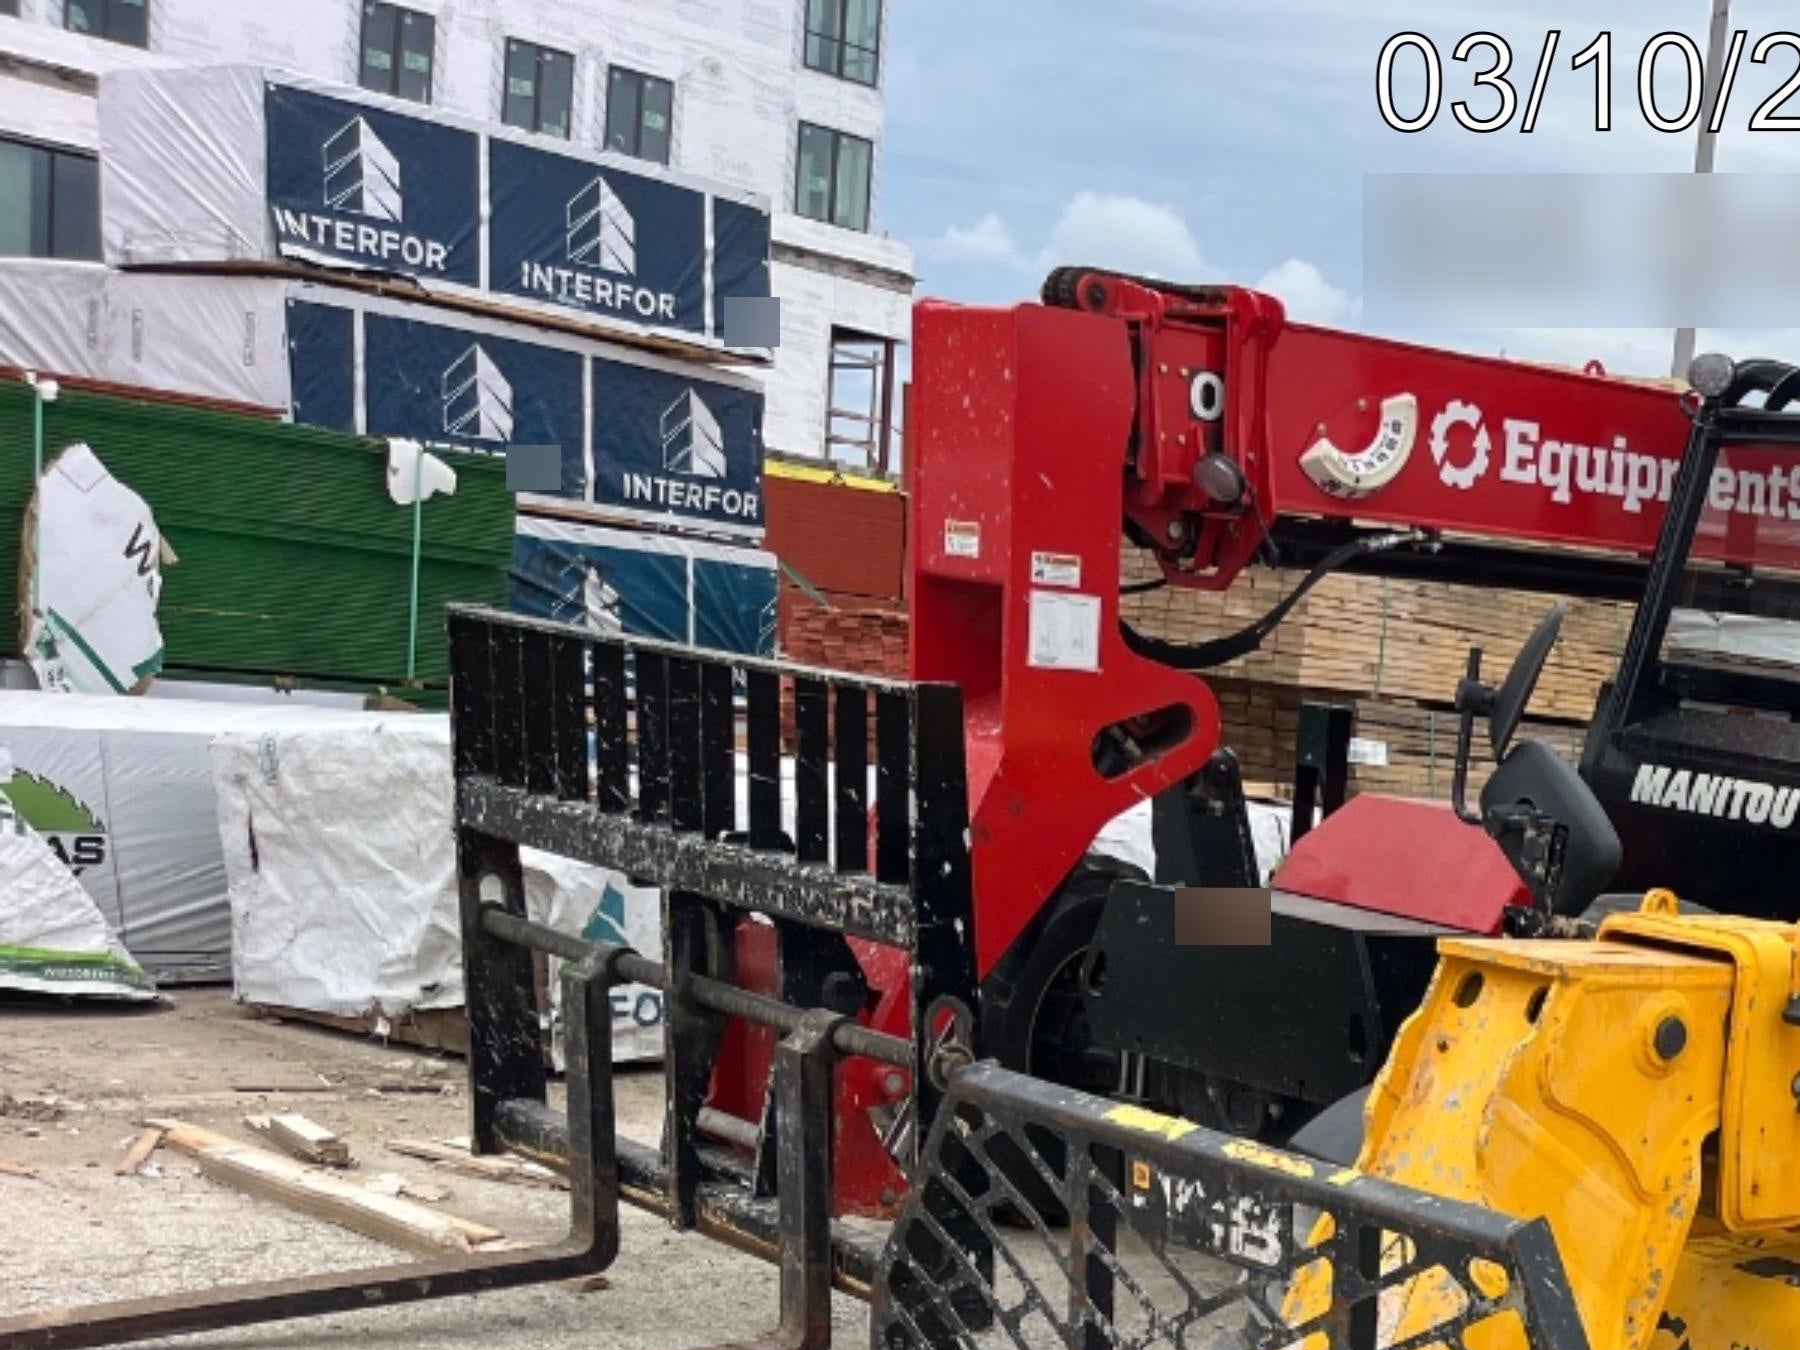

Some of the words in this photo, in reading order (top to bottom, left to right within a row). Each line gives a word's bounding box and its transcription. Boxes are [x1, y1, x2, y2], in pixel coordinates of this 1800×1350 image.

[273, 205, 449, 272] INTERFOR
[521, 260, 677, 320] INTERFOR
[622, 472, 759, 518] INTERFOR
